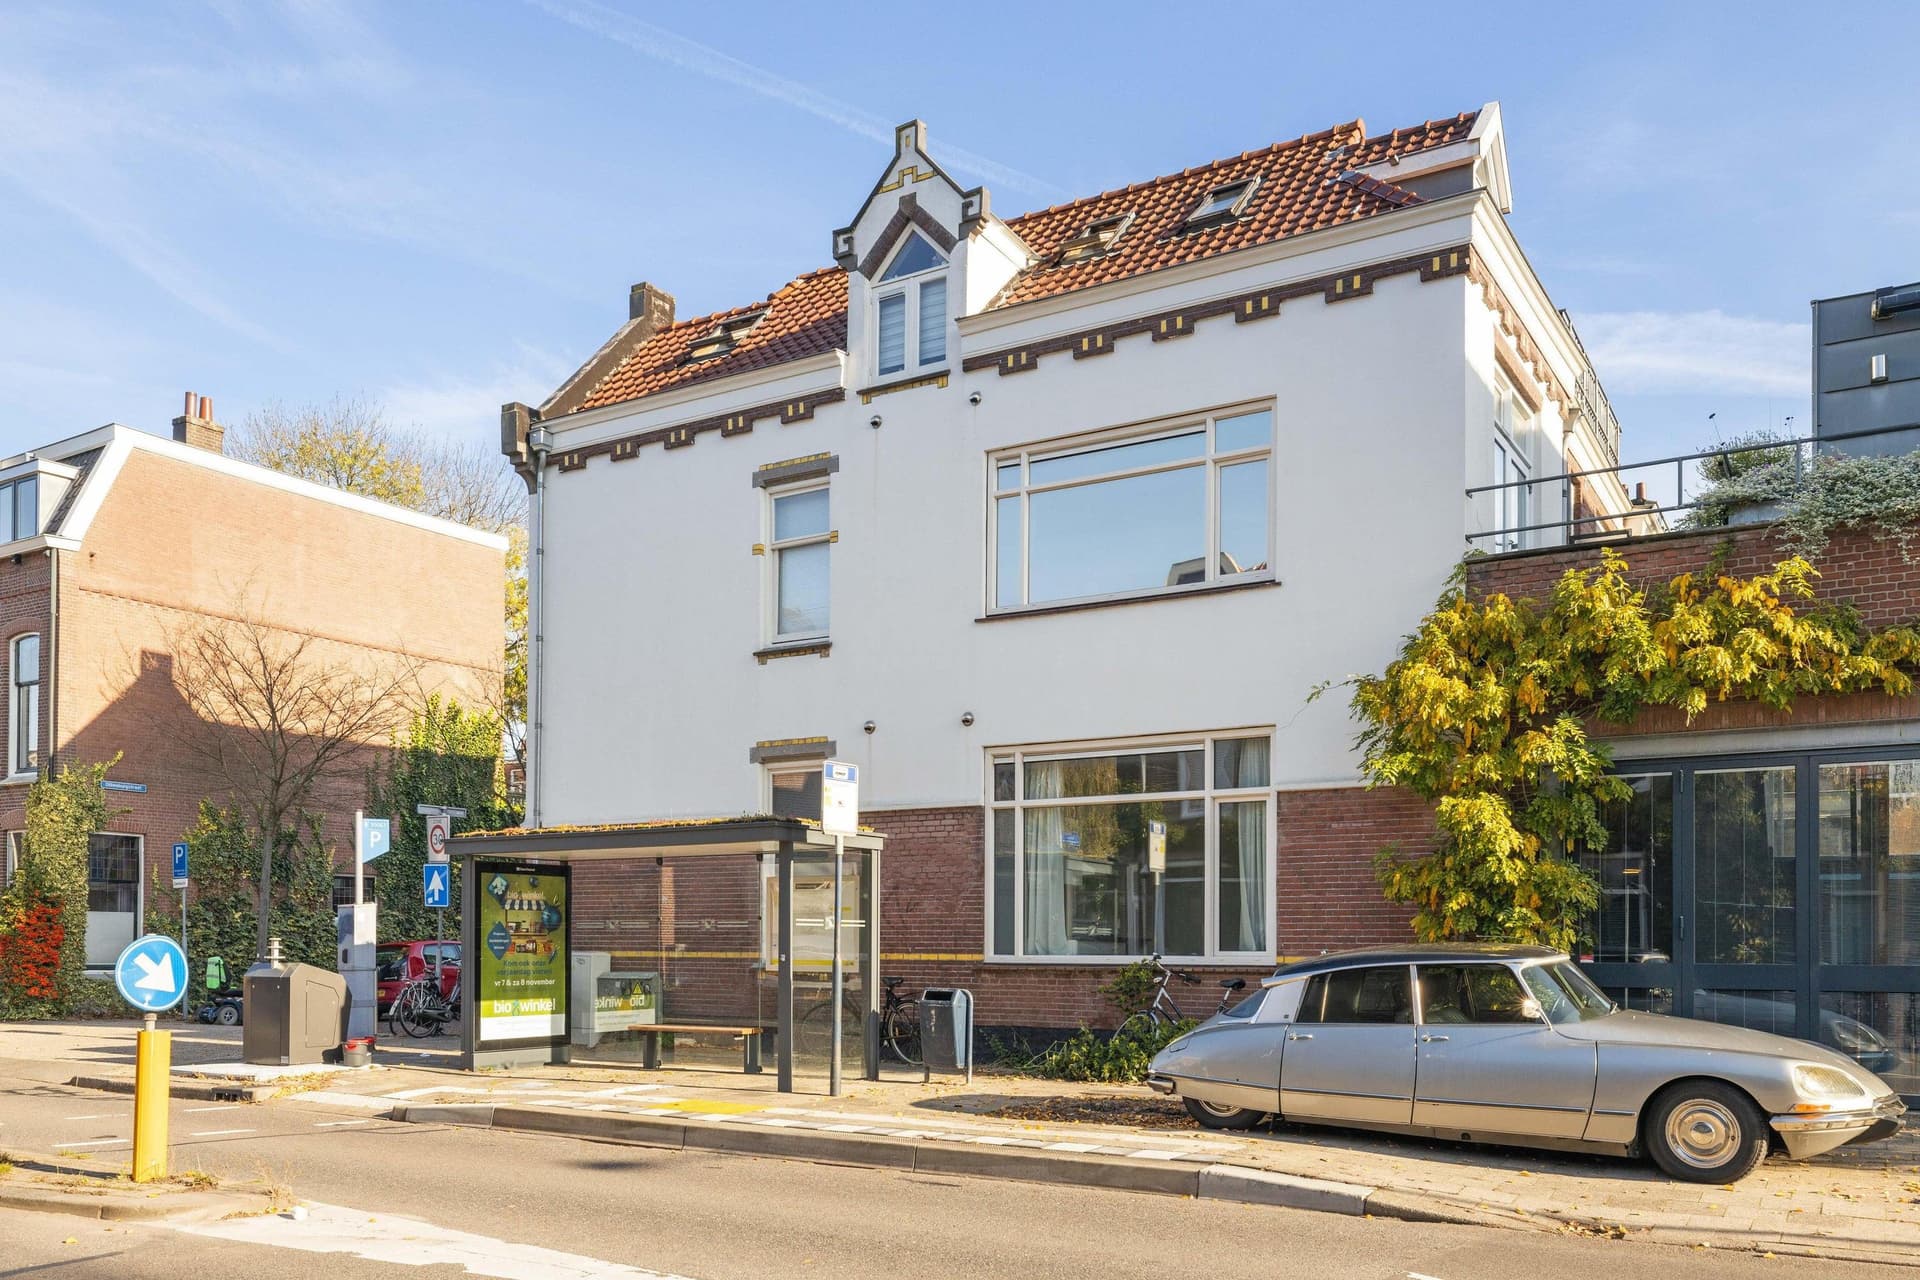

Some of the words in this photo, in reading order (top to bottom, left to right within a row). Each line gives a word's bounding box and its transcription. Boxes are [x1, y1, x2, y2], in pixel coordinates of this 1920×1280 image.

[370, 831, 381, 848] P
[432, 833, 443, 845] 30
[175, 846, 184, 864] P
[494, 1000, 512, 1013] bio
[520, 998, 556, 1012] winkel
